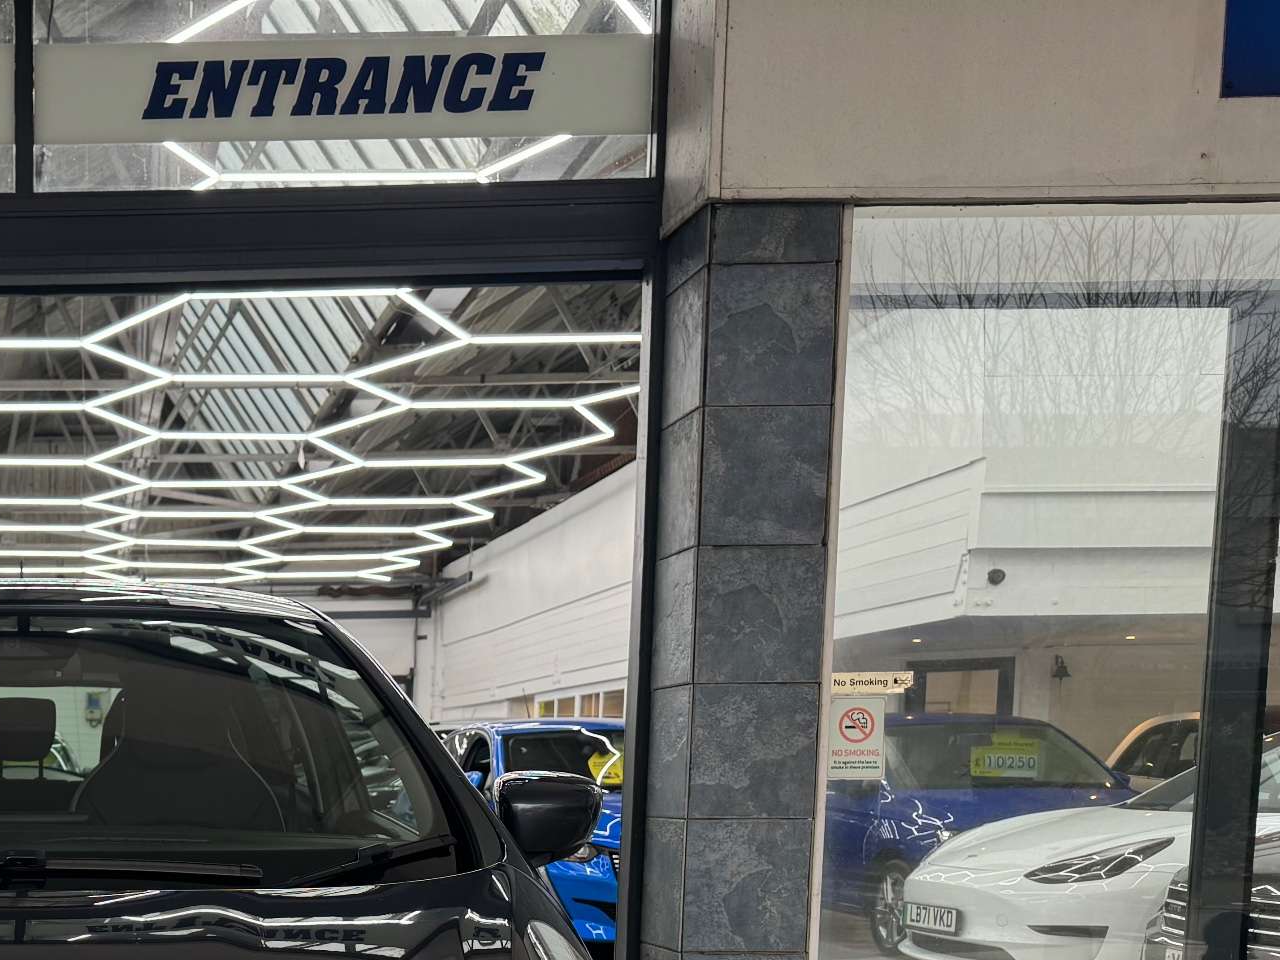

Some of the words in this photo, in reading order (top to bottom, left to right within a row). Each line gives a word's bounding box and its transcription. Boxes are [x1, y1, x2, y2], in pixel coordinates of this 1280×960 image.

[141, 52, 546, 120] ENTRANCE
[833, 679, 846, 687] No
[849, 677, 888, 687] Smoking
[831, 749, 843, 757] NO
[845, 749, 880, 757] SMOKING
[909, 904, 930, 925] LB71
[933, 908, 953, 928] VKD
